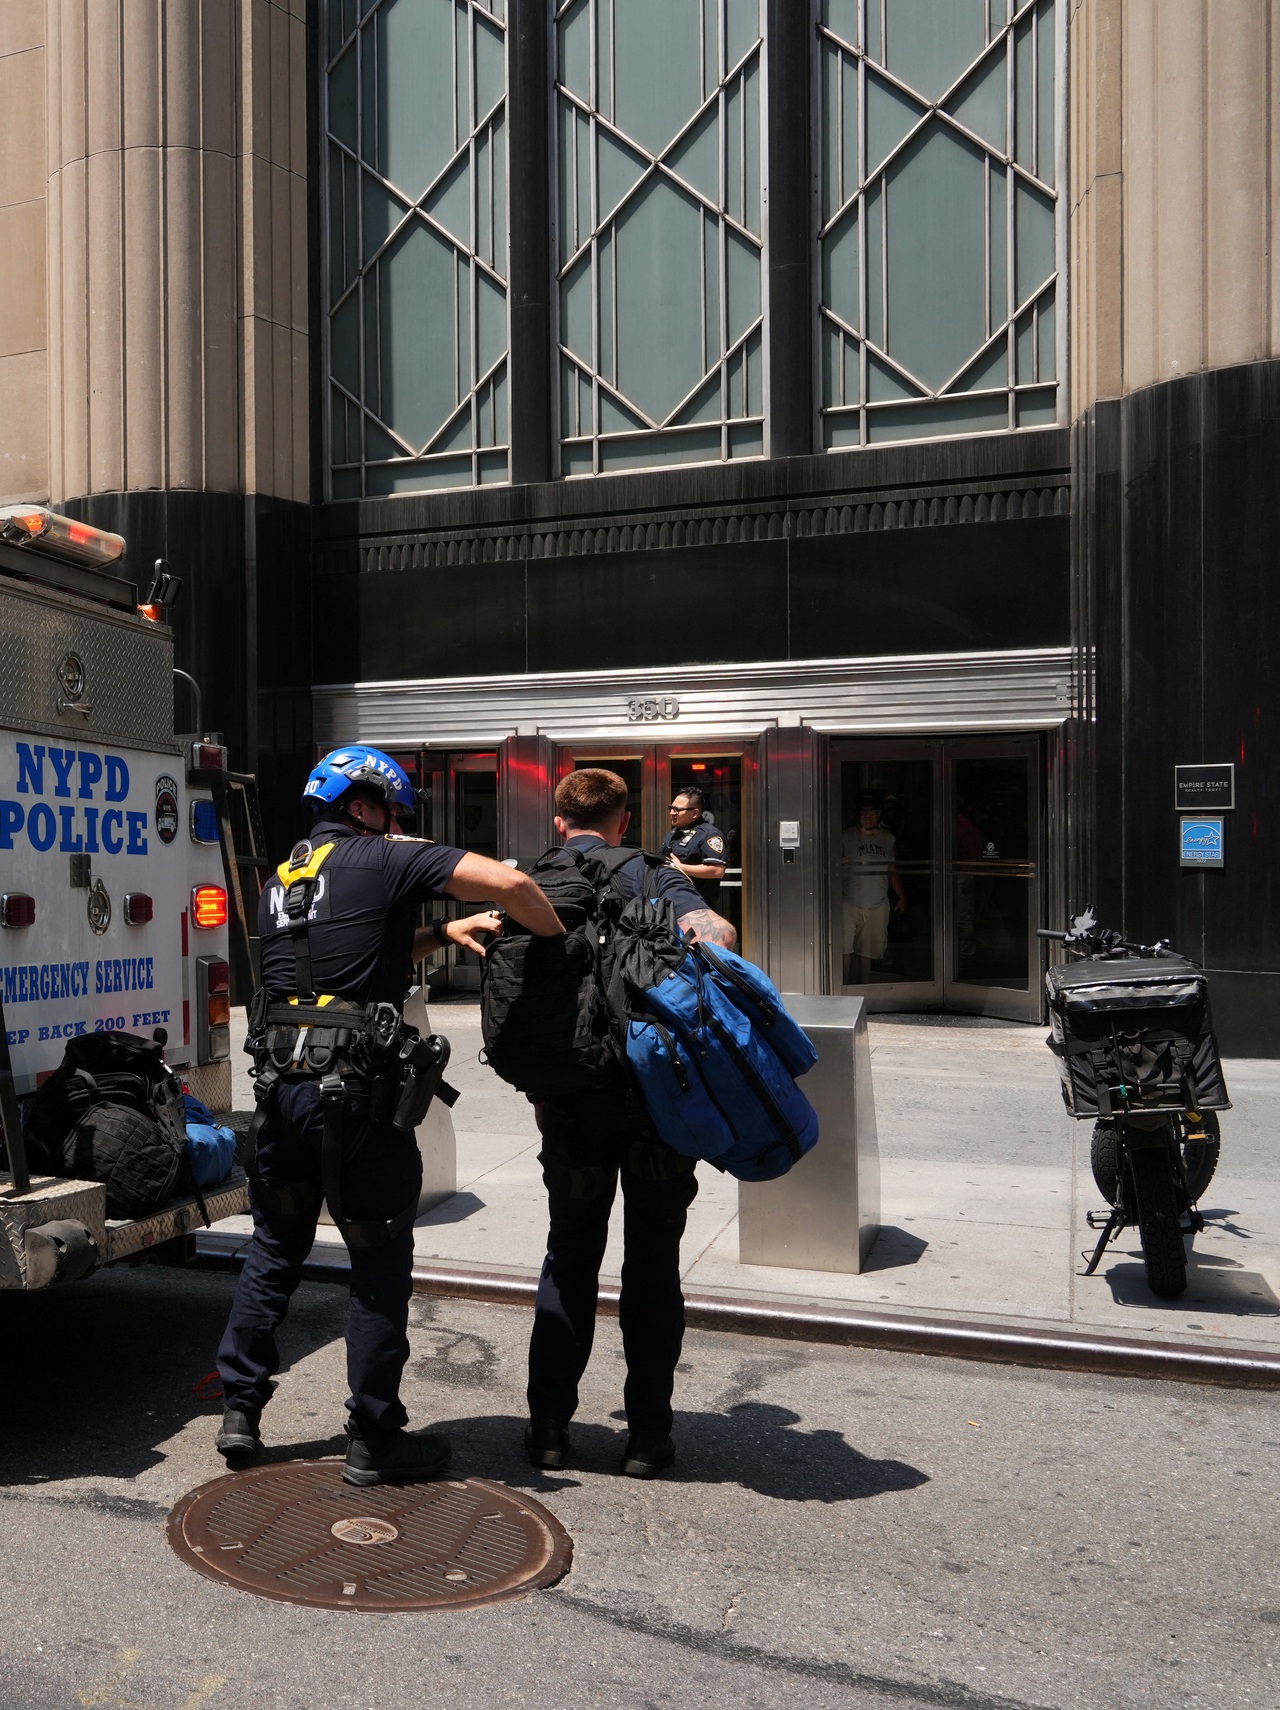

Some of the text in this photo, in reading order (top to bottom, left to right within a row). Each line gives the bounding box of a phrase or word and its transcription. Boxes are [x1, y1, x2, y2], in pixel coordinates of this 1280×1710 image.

[625, 696, 680, 718] 350
[16, 742, 130, 802] NYPD
[364, 754, 402, 791] NYPD
[858, 844, 885, 857] MIAMI
[1205, 851, 1221, 859] STAR
[96, 957, 154, 994] SERVICE
[38, 1021, 87, 1041] BACK
[95, 1016, 125, 1032] 200
[132, 1010, 170, 1027] FEET
